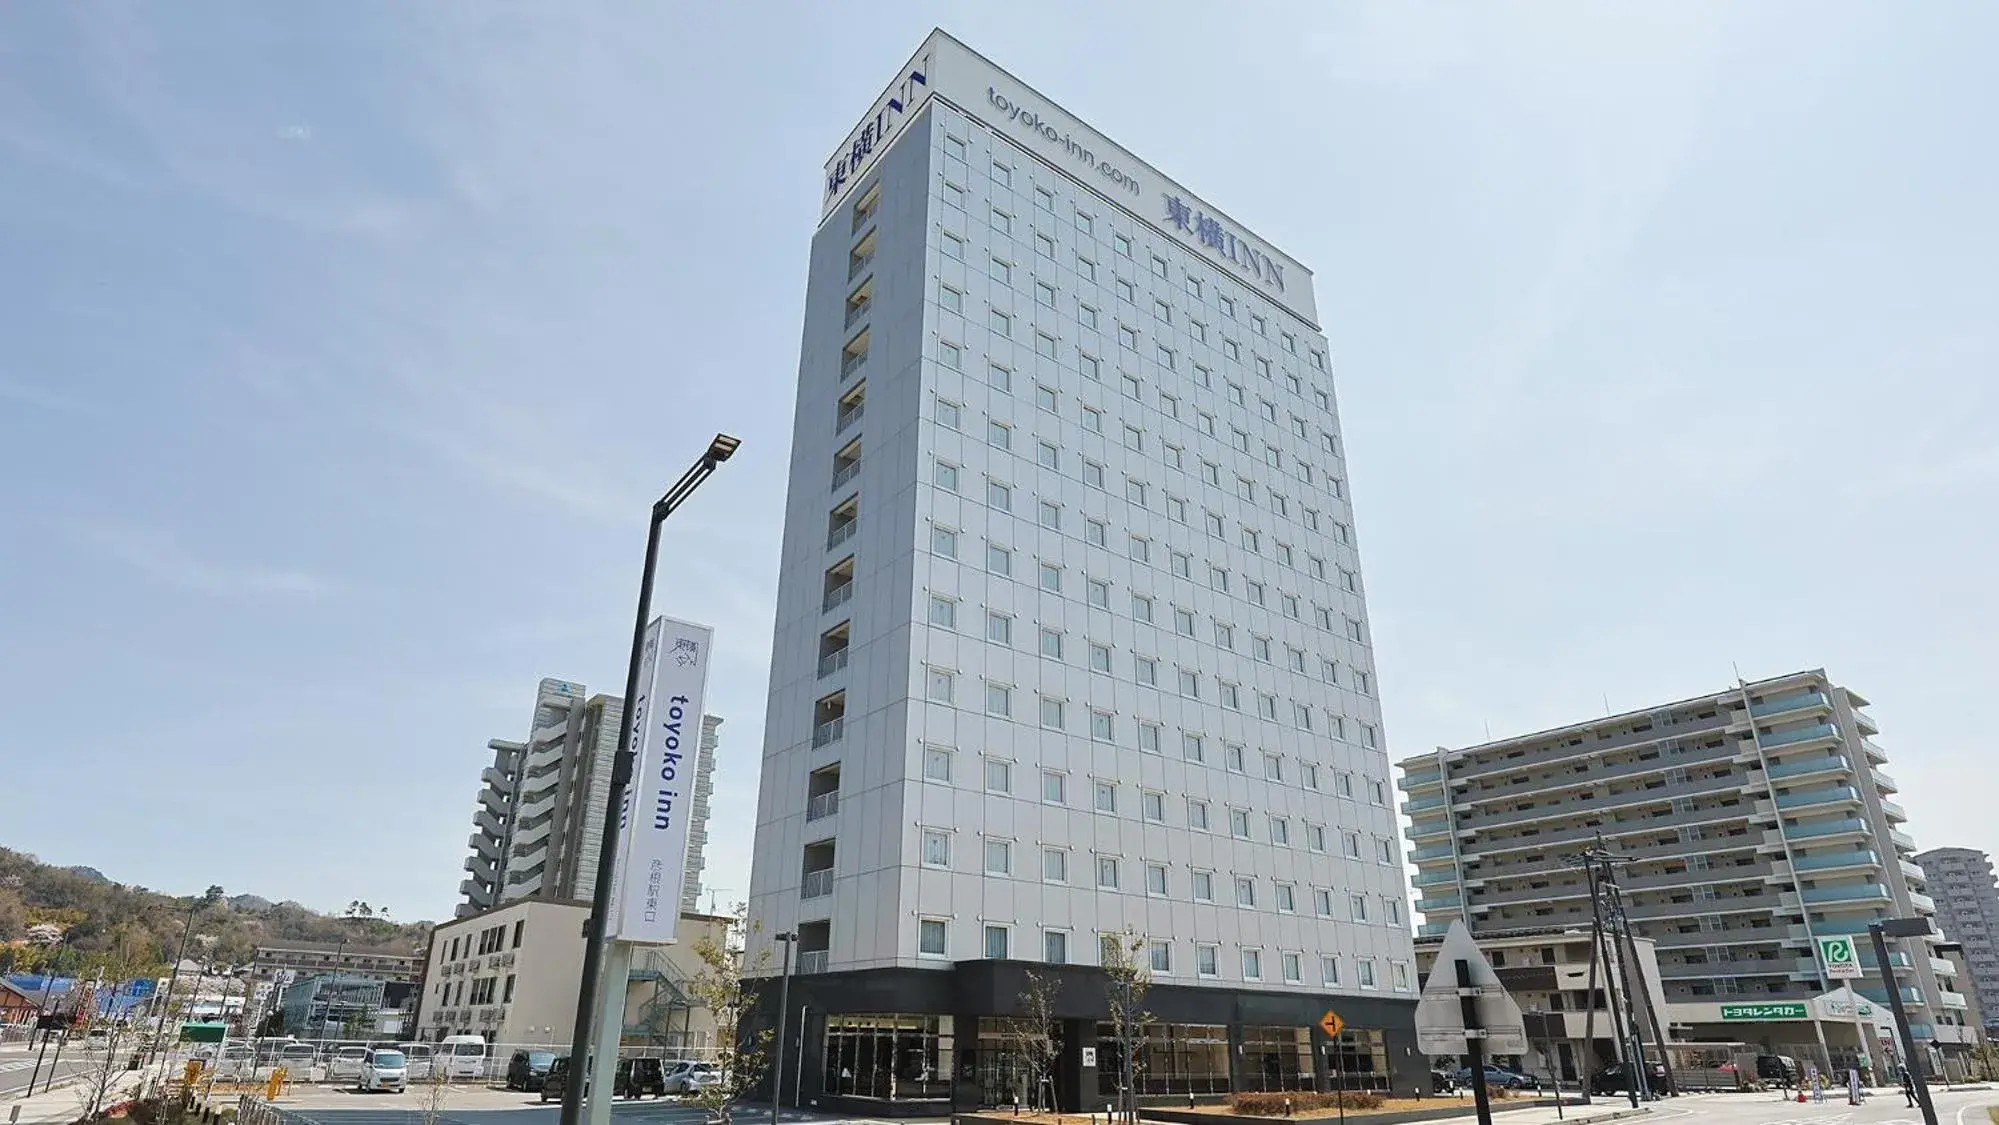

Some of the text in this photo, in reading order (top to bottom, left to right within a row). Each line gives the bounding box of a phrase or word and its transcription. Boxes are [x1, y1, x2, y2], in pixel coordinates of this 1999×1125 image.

[826, 54, 929, 203] 東横INN
[986, 86, 1141, 196] toyoko-inn.com
[1161, 193, 1284, 292] 東横INN
[660, 694, 690, 782] toyoko
[654, 789, 678, 831] inn
[1723, 1004, 1805, 1017] トヨタレンタカー
